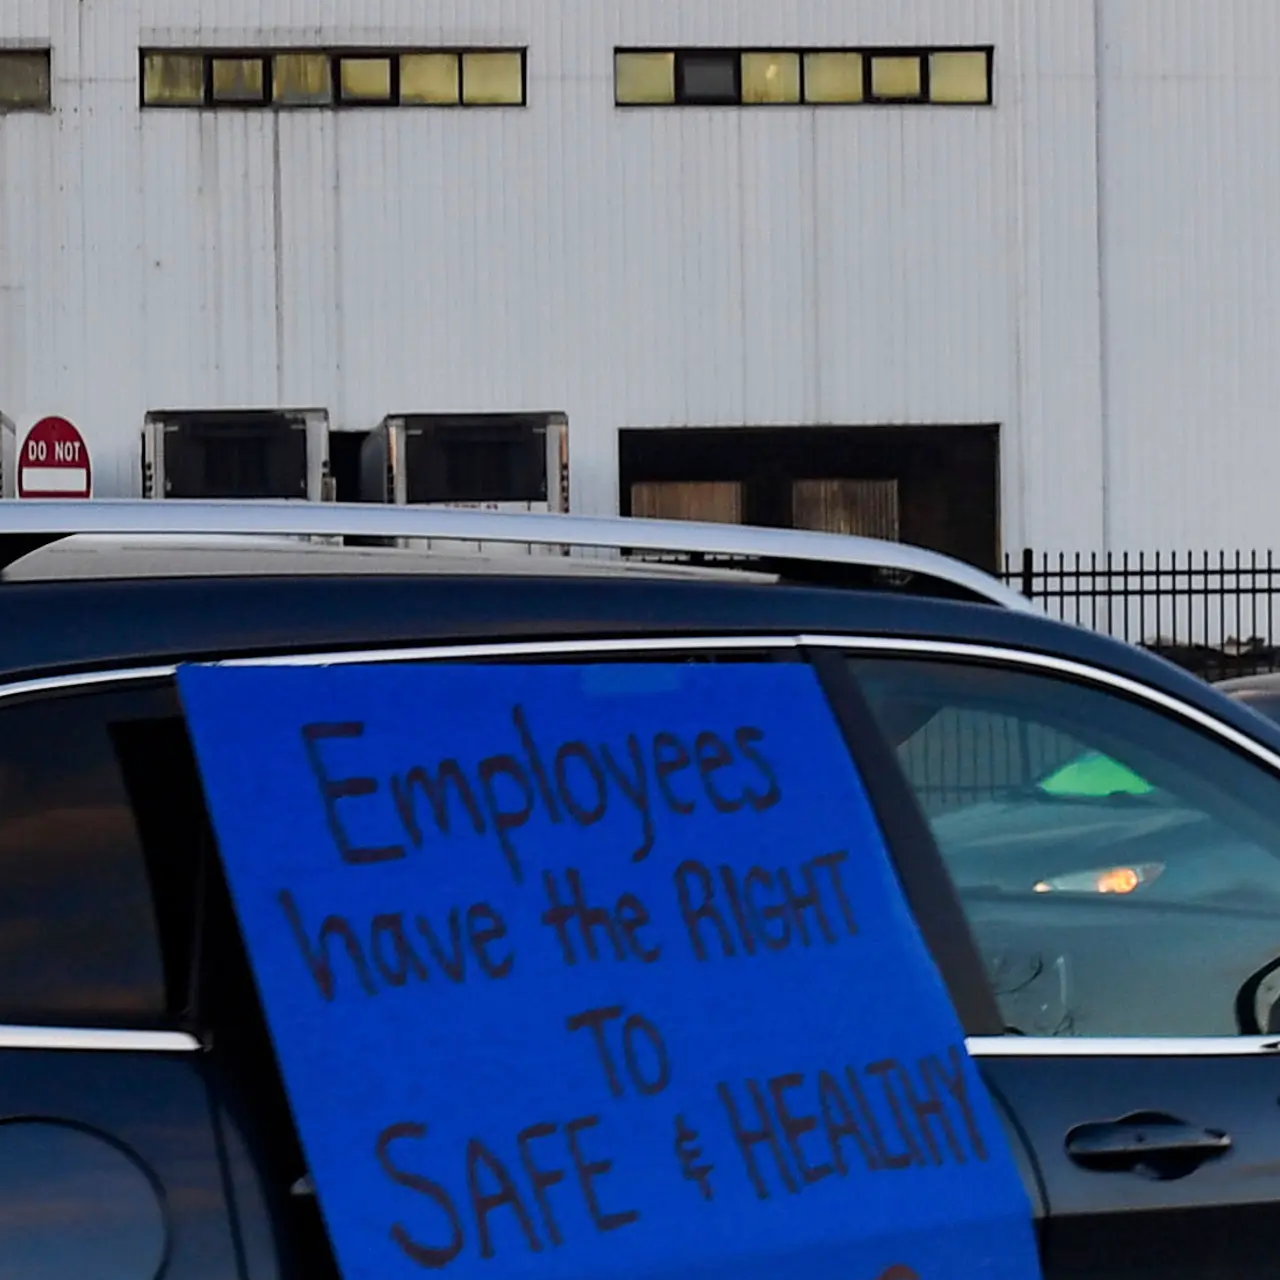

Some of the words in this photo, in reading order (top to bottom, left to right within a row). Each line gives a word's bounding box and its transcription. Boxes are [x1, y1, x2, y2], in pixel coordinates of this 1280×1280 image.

[28, 440, 47, 461] DO
[55, 440, 80, 462] NOT
[301, 706, 781, 882] Employees
[278, 888, 514, 1002] have
[542, 868, 662, 966] the
[674, 850, 860, 962] RIGHT
[565, 1005, 671, 1098] TO
[376, 1114, 640, 1268] SAFE
[717, 1045, 990, 1200] HEALTHY
